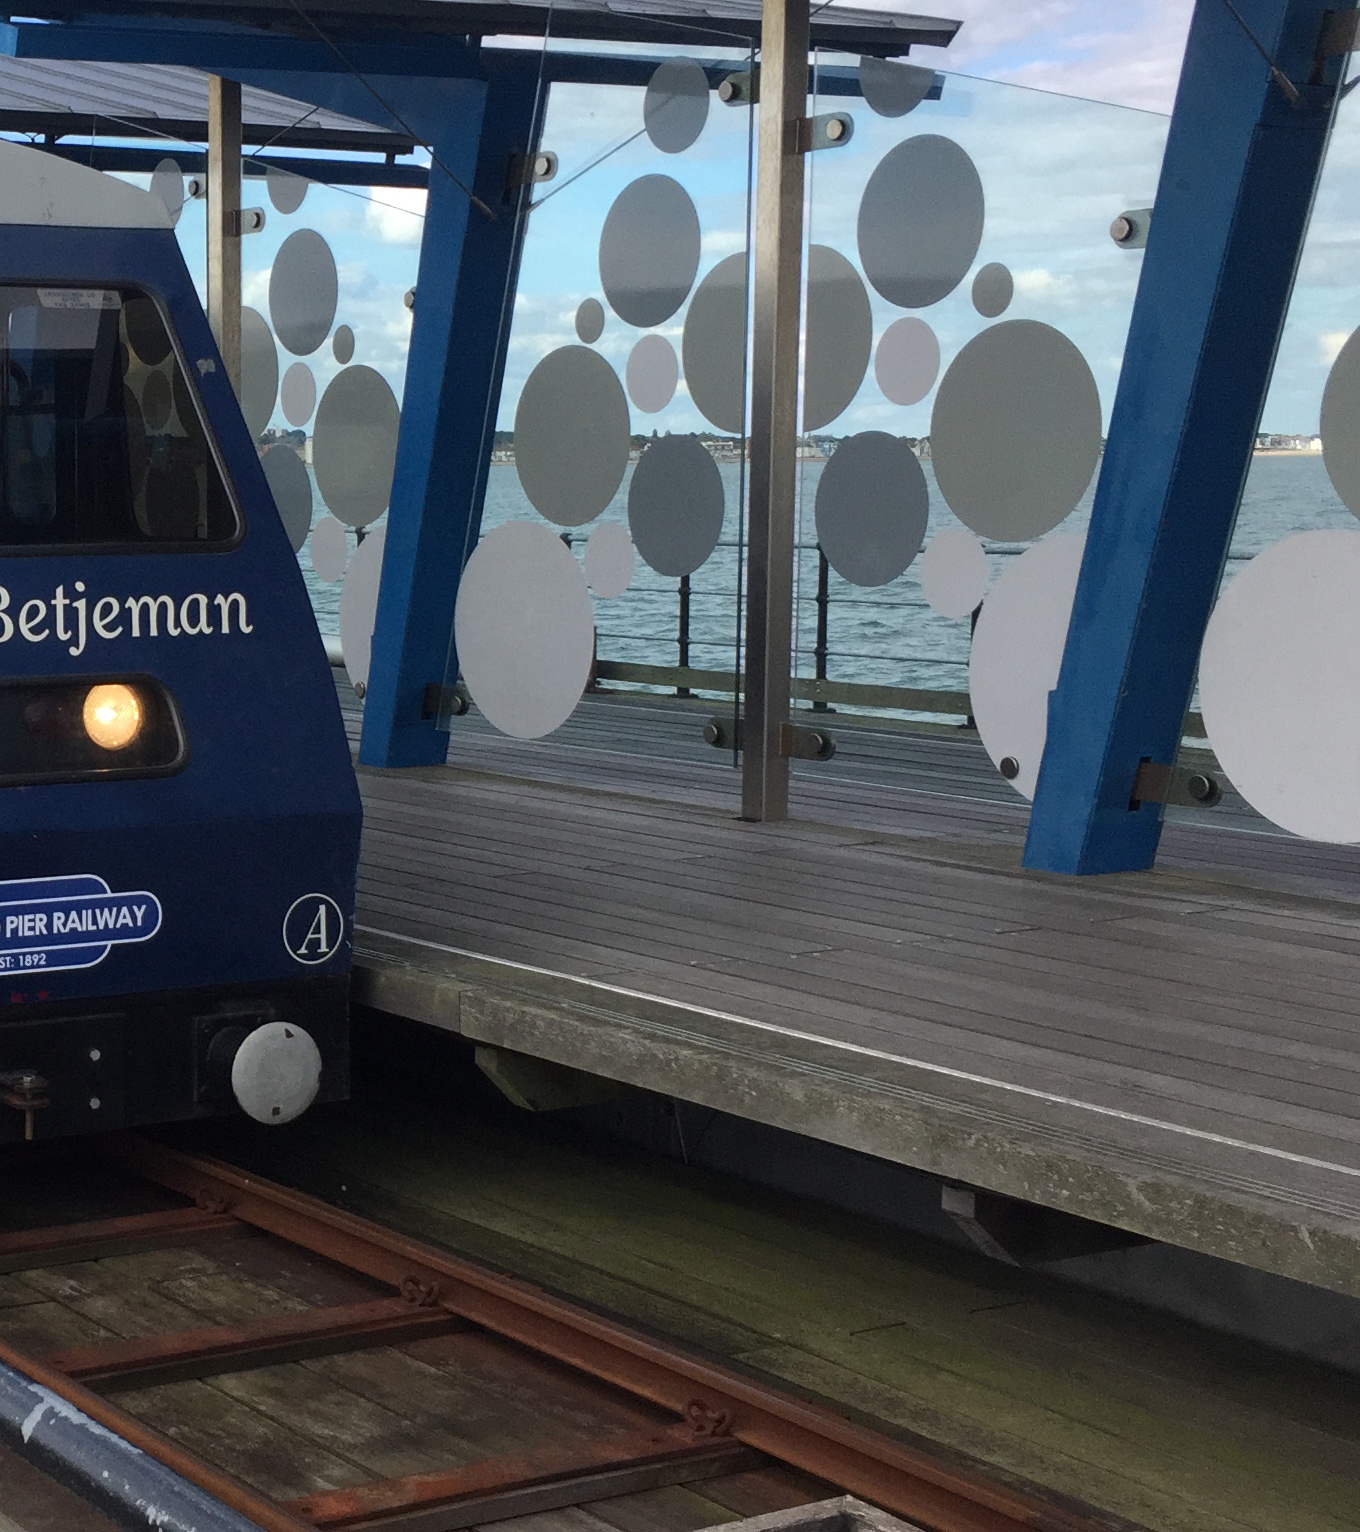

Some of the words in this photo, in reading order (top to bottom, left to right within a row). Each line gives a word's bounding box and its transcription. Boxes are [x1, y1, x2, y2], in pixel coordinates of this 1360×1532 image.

[5, 912, 49, 939] PIER
[52, 904, 147, 934] RAILWAY
[296, 904, 330, 954] A
[18, 953, 47, 967] 1892
